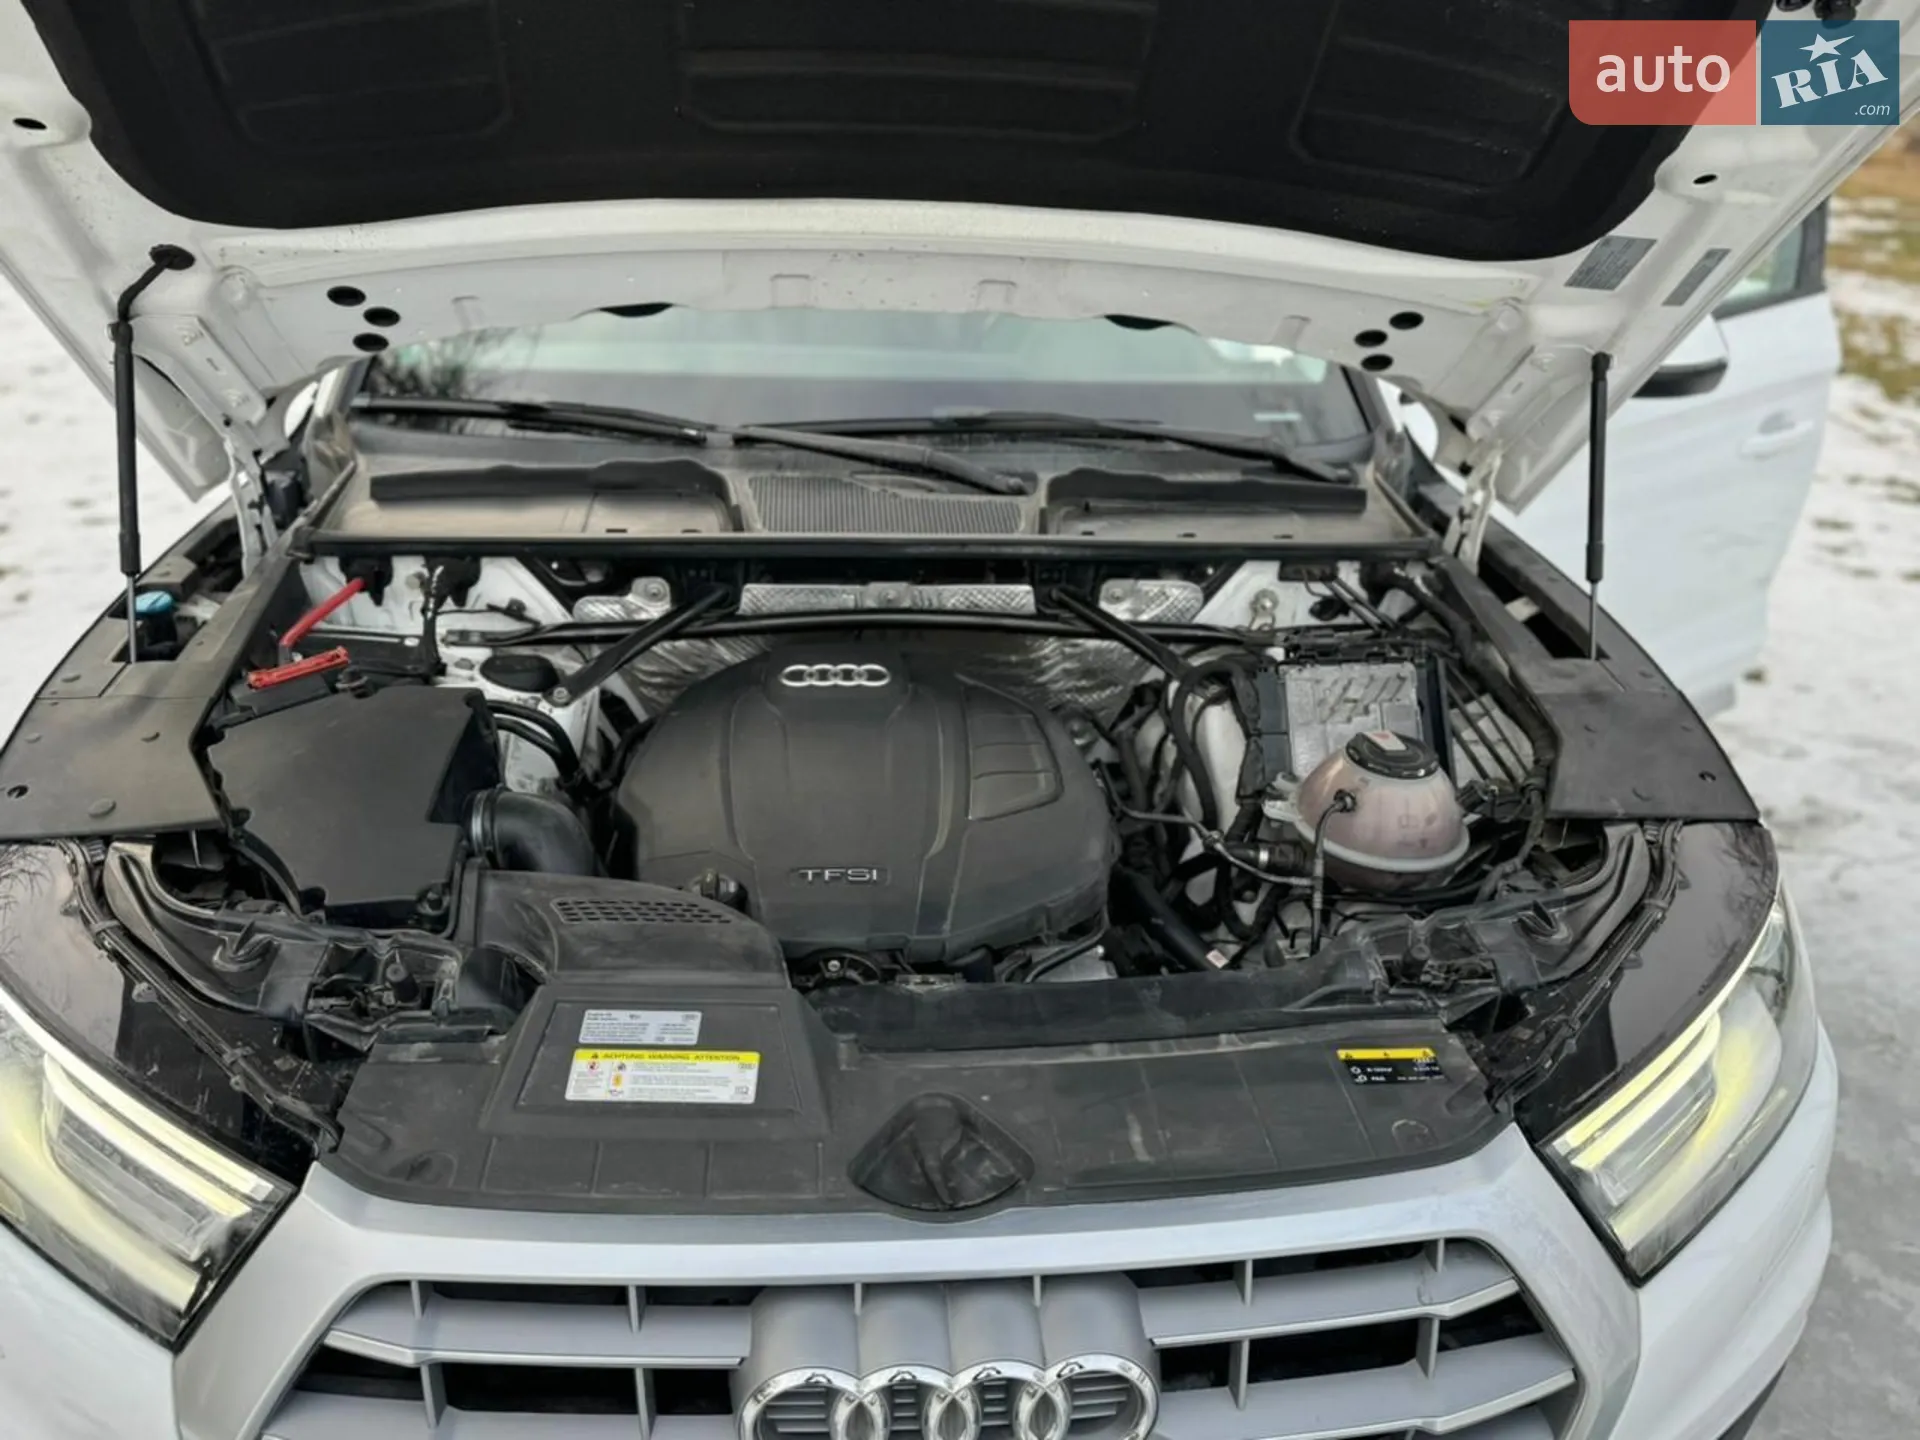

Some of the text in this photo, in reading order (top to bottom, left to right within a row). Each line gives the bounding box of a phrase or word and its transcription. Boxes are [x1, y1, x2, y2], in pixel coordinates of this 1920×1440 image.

[799, 868, 877, 881] TFSI
[602, 1052, 740, 1062] ACHTUNG WARNING ATTENTION
